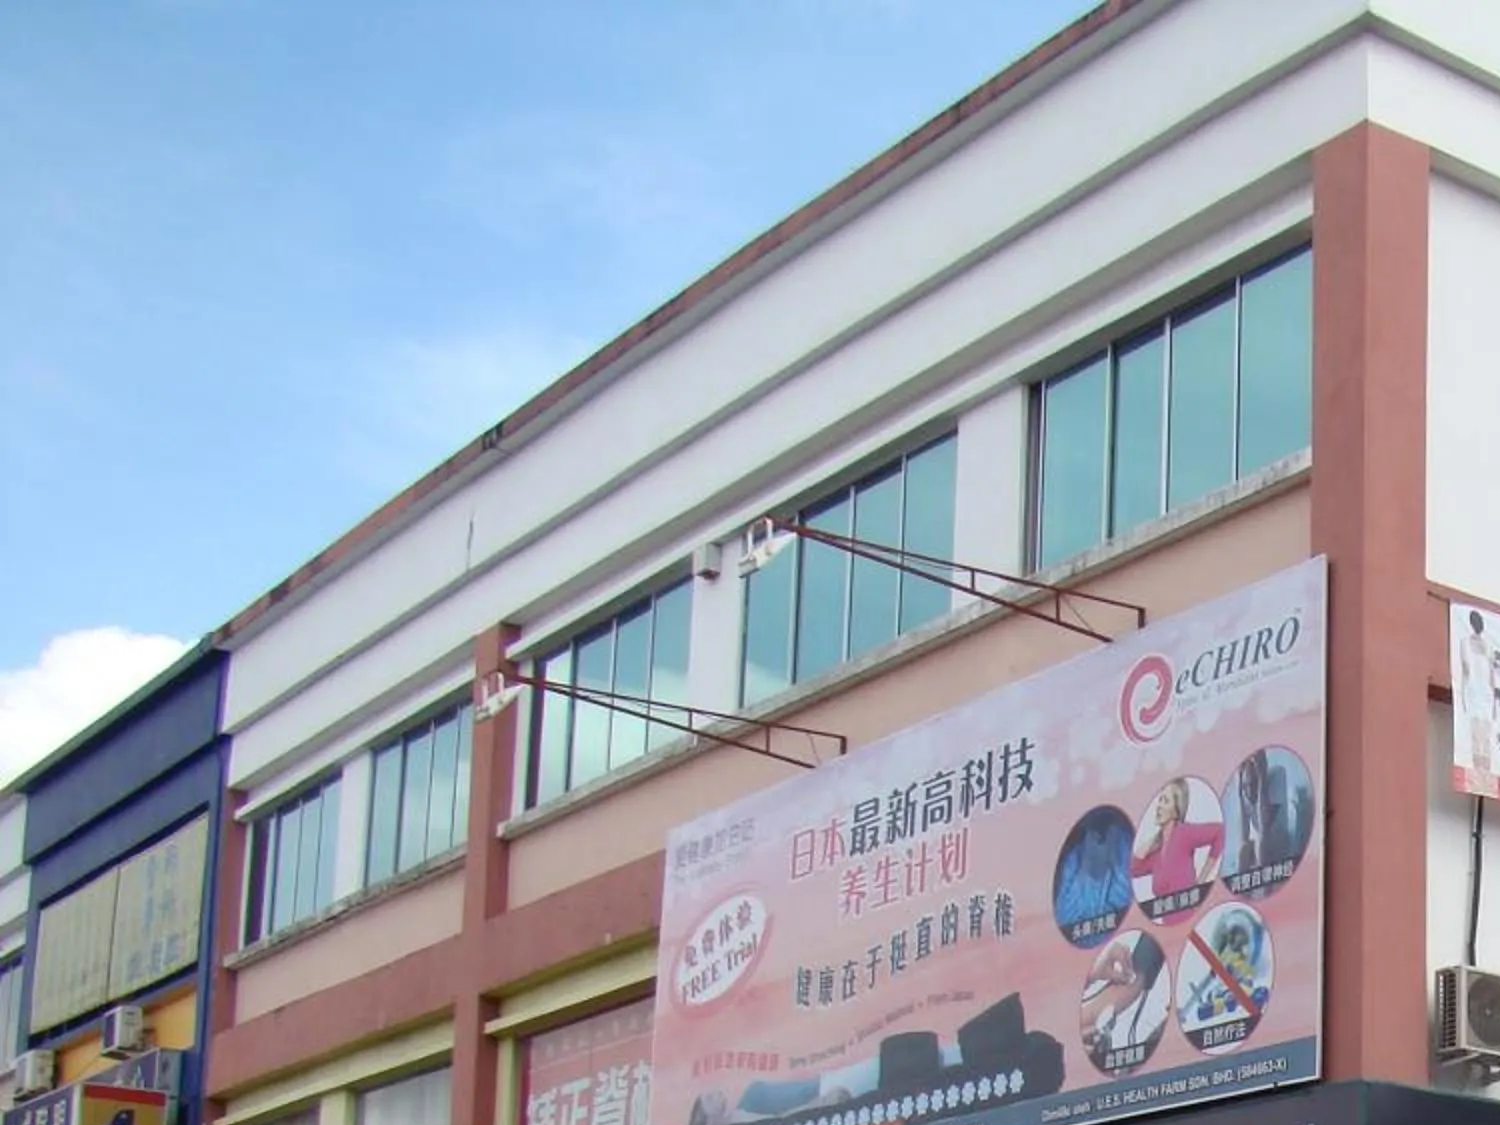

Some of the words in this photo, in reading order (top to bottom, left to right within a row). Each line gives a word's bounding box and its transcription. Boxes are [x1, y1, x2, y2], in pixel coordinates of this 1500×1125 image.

[790, 736, 1036, 881] 日本最新高科技
[840, 827, 969, 917] 养生计划
[681, 959, 721, 1004] FREE
[726, 932, 758, 972] Trial
[796, 893, 1013, 1008] 健康在于挺直的脊椎
[1123, 1085, 1159, 1105] HEALTH
[1160, 1079, 1187, 1098] FARM
